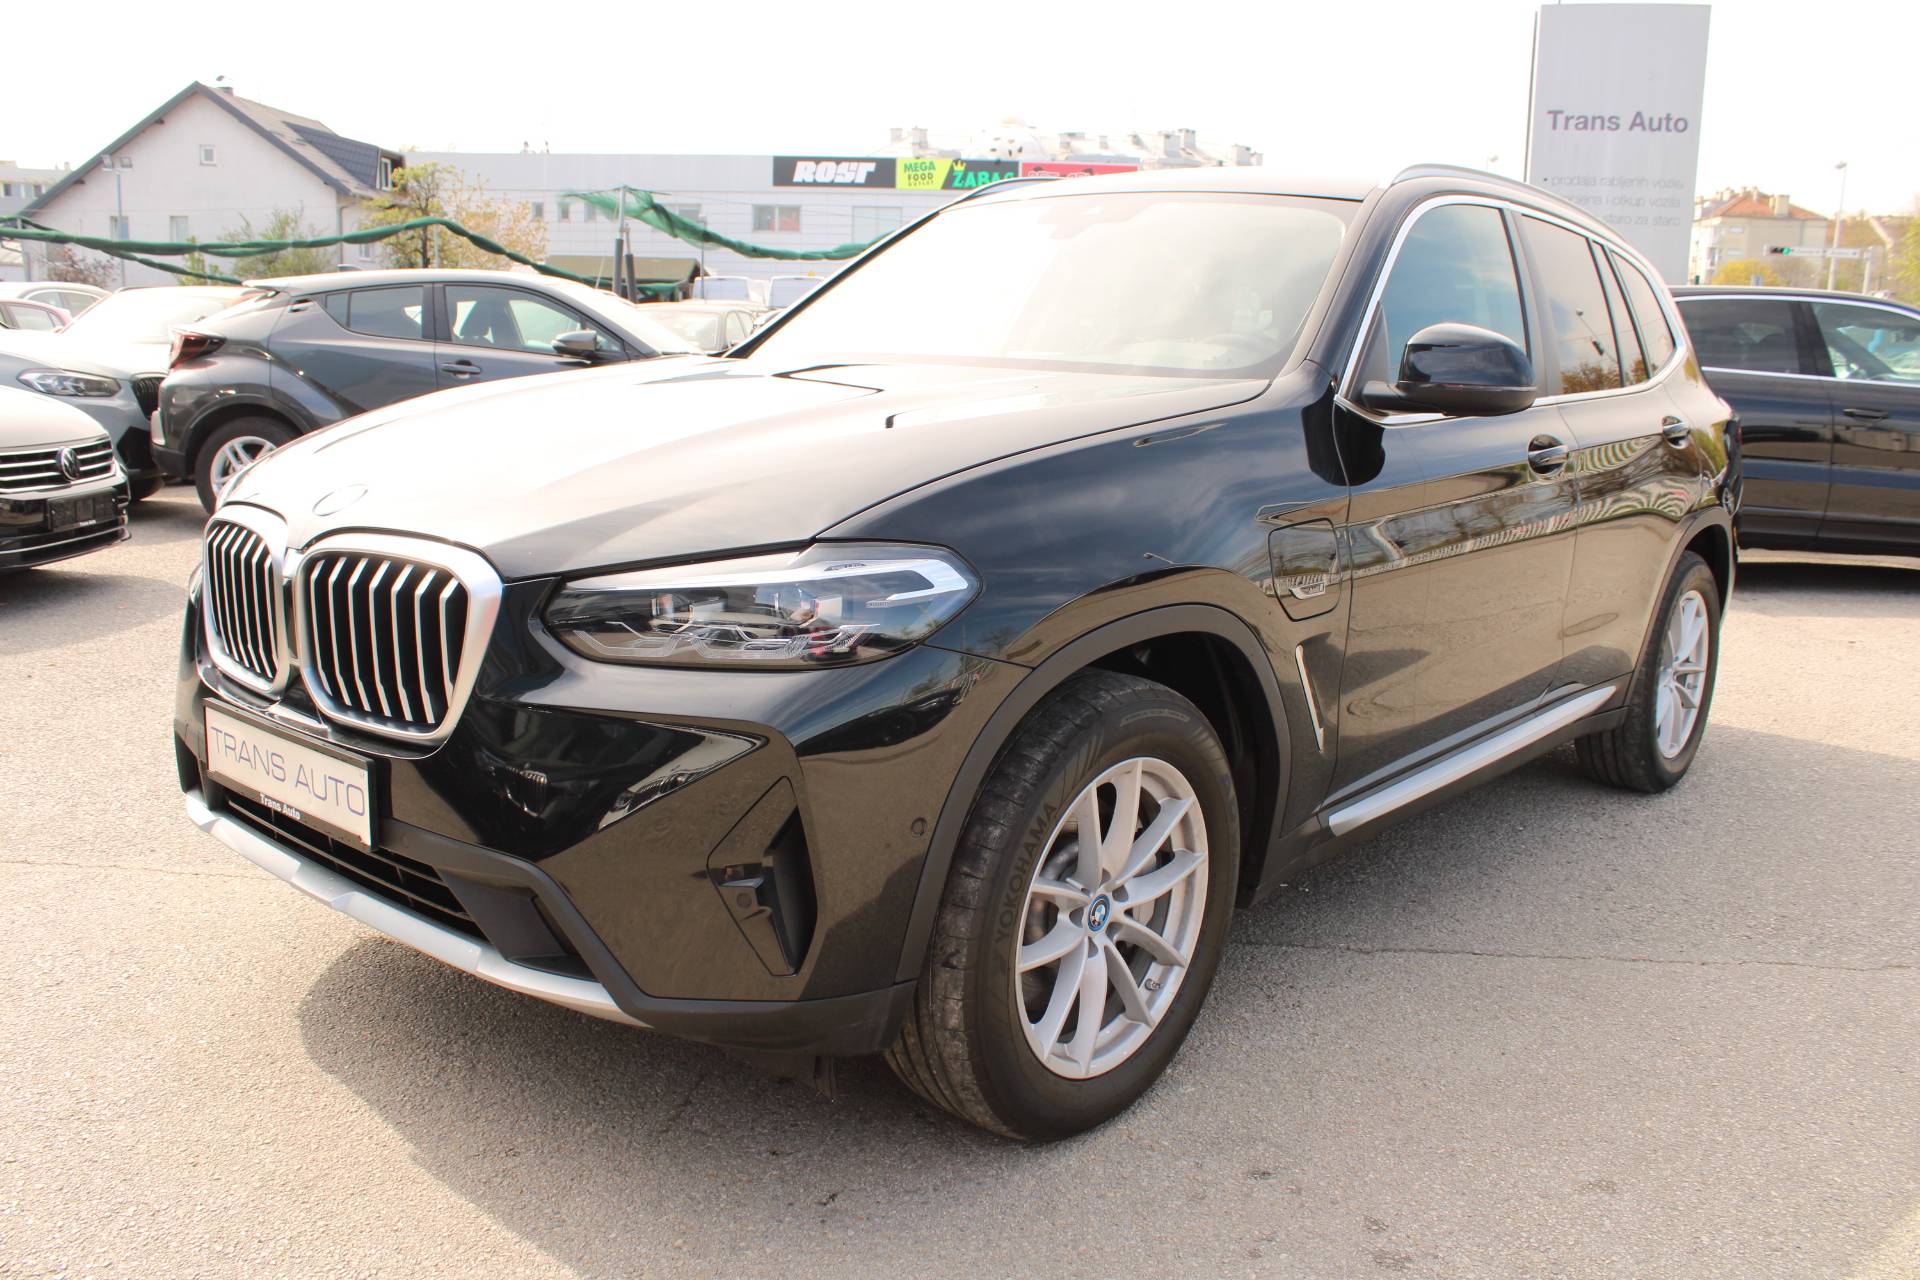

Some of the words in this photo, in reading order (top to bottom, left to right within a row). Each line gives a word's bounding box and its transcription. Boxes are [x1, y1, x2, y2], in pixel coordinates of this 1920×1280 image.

[1547, 109, 1620, 132] Trans
[1628, 111, 1689, 133] Auto
[792, 160, 877, 183] ROST
[904, 161, 936, 172] MEGA
[907, 172, 934, 181] FOOD
[211, 726, 286, 783] TRANS
[294, 763, 366, 817] AUTO
[260, 793, 282, 811] Trans
[282, 803, 301, 820] Auto
[996, 802, 1058, 944] YOKOHAMA
